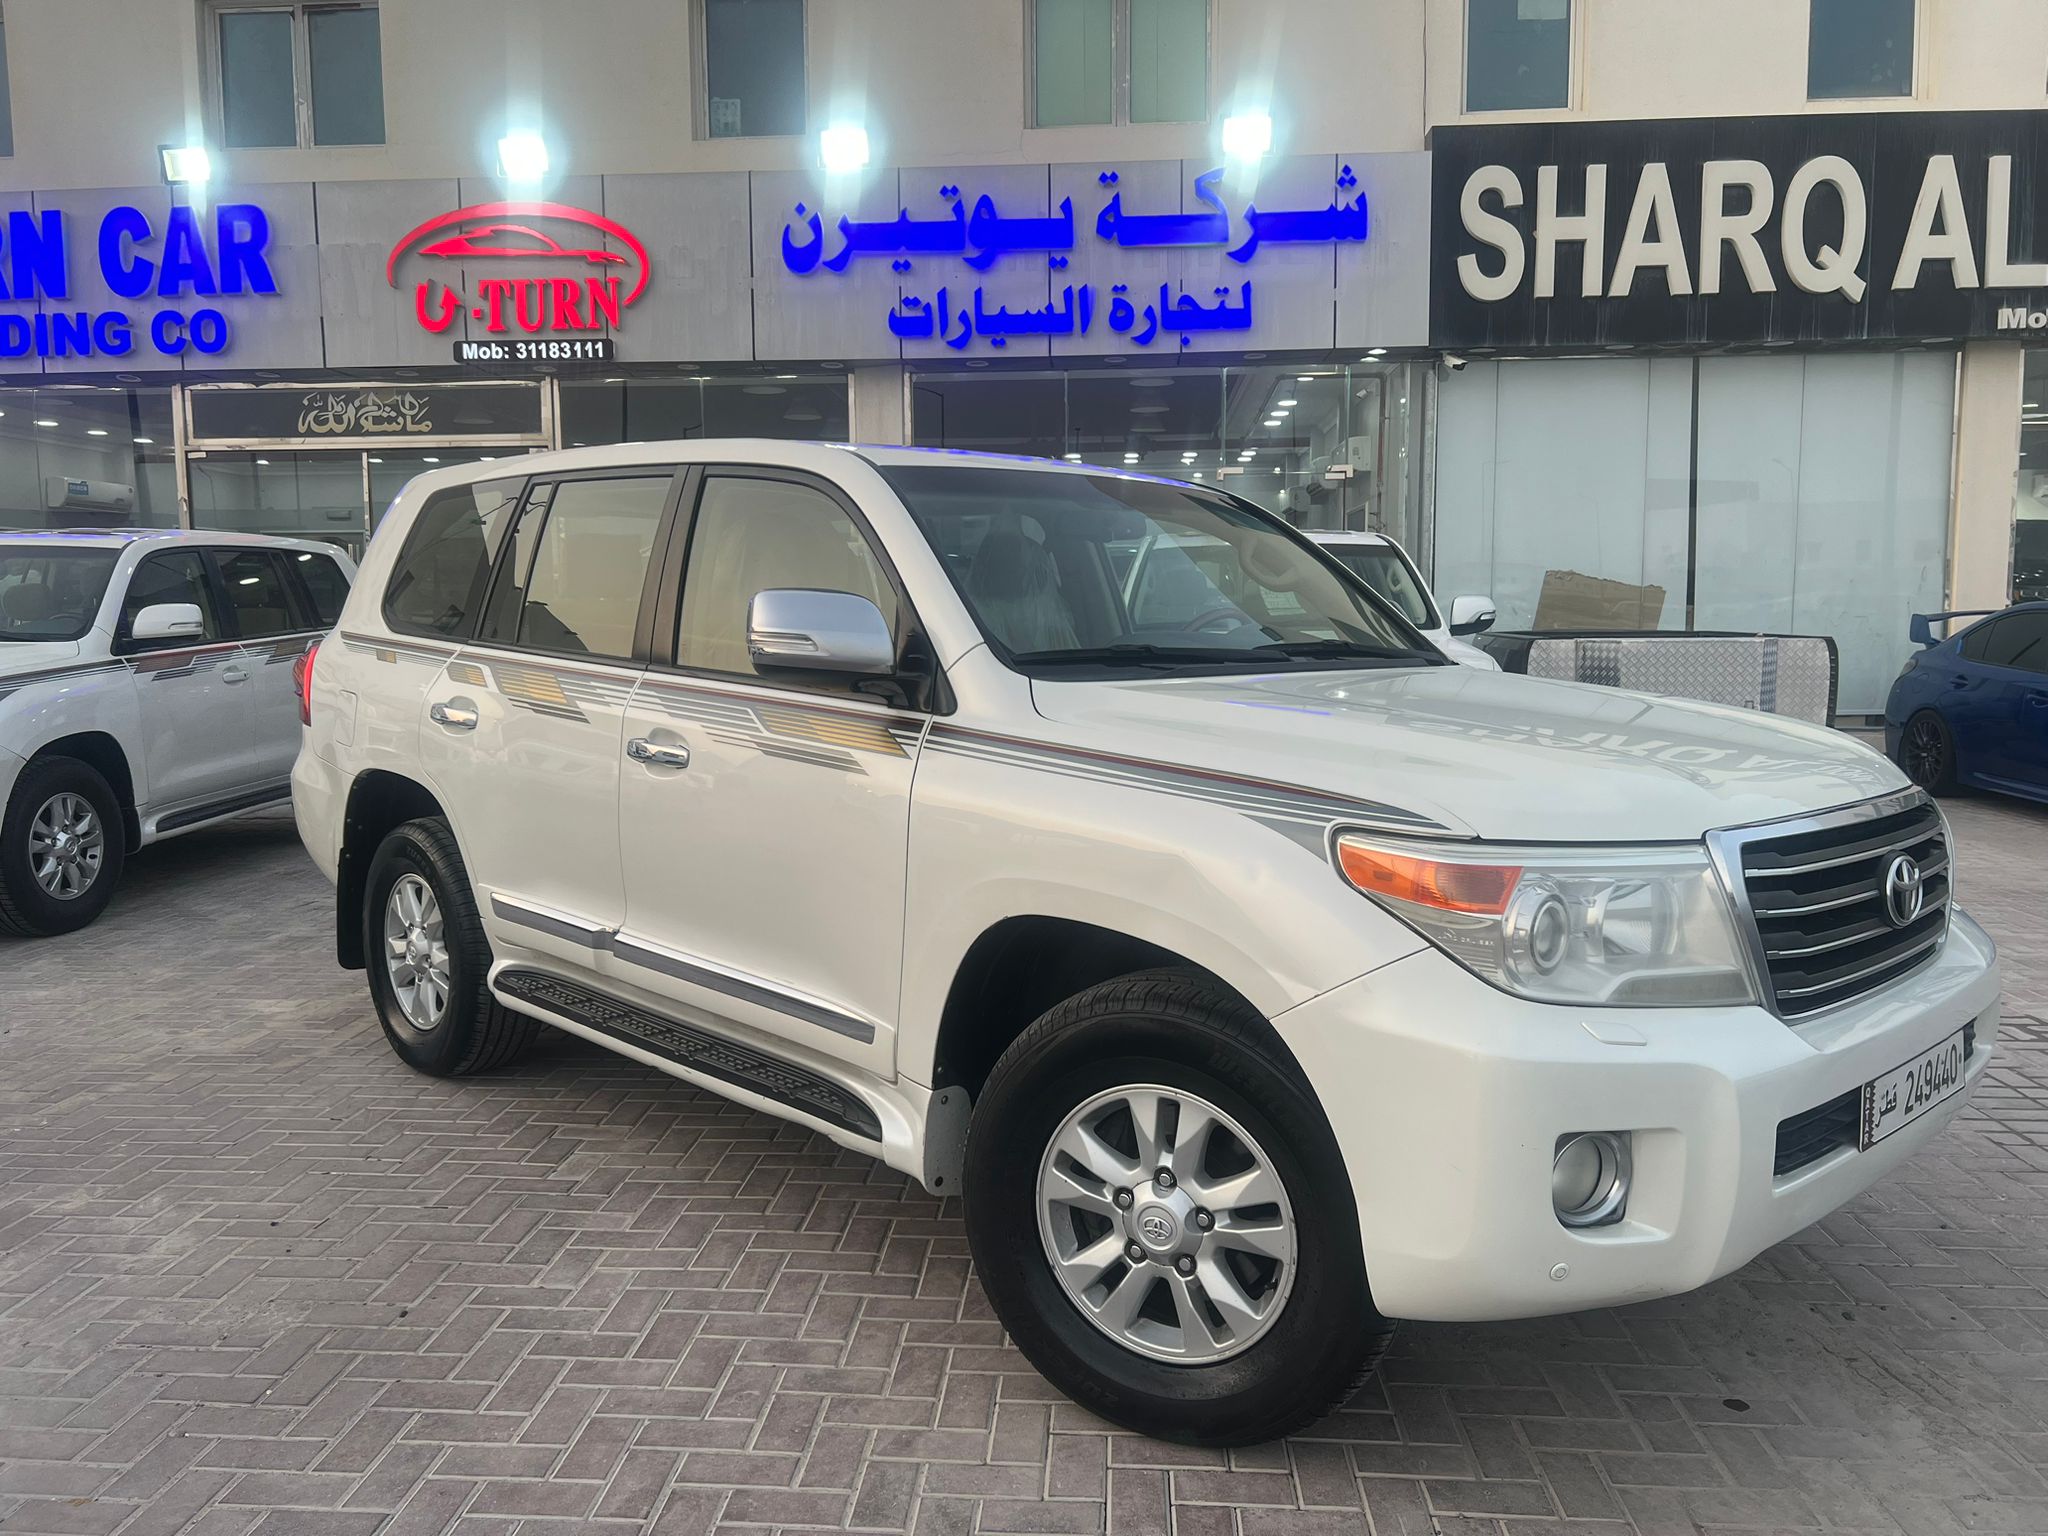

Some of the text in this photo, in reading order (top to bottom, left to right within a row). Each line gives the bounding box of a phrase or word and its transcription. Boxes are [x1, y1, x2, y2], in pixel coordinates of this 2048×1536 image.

[0, 204, 279, 300] N CAR
[781, 164, 1369, 275] شركة يوتيرن
[1457, 155, 2048, 303] SHARQ AL
[0, 309, 229, 358] DING CO
[888, 280, 1253, 350] لتجارة السيارات
[1997, 307, 2048, 330] Mo
[462, 341, 604, 360] Mob: 31183111
[1875, 1082, 1898, 1128] قطر
[1904, 1043, 1958, 1116] 249440
